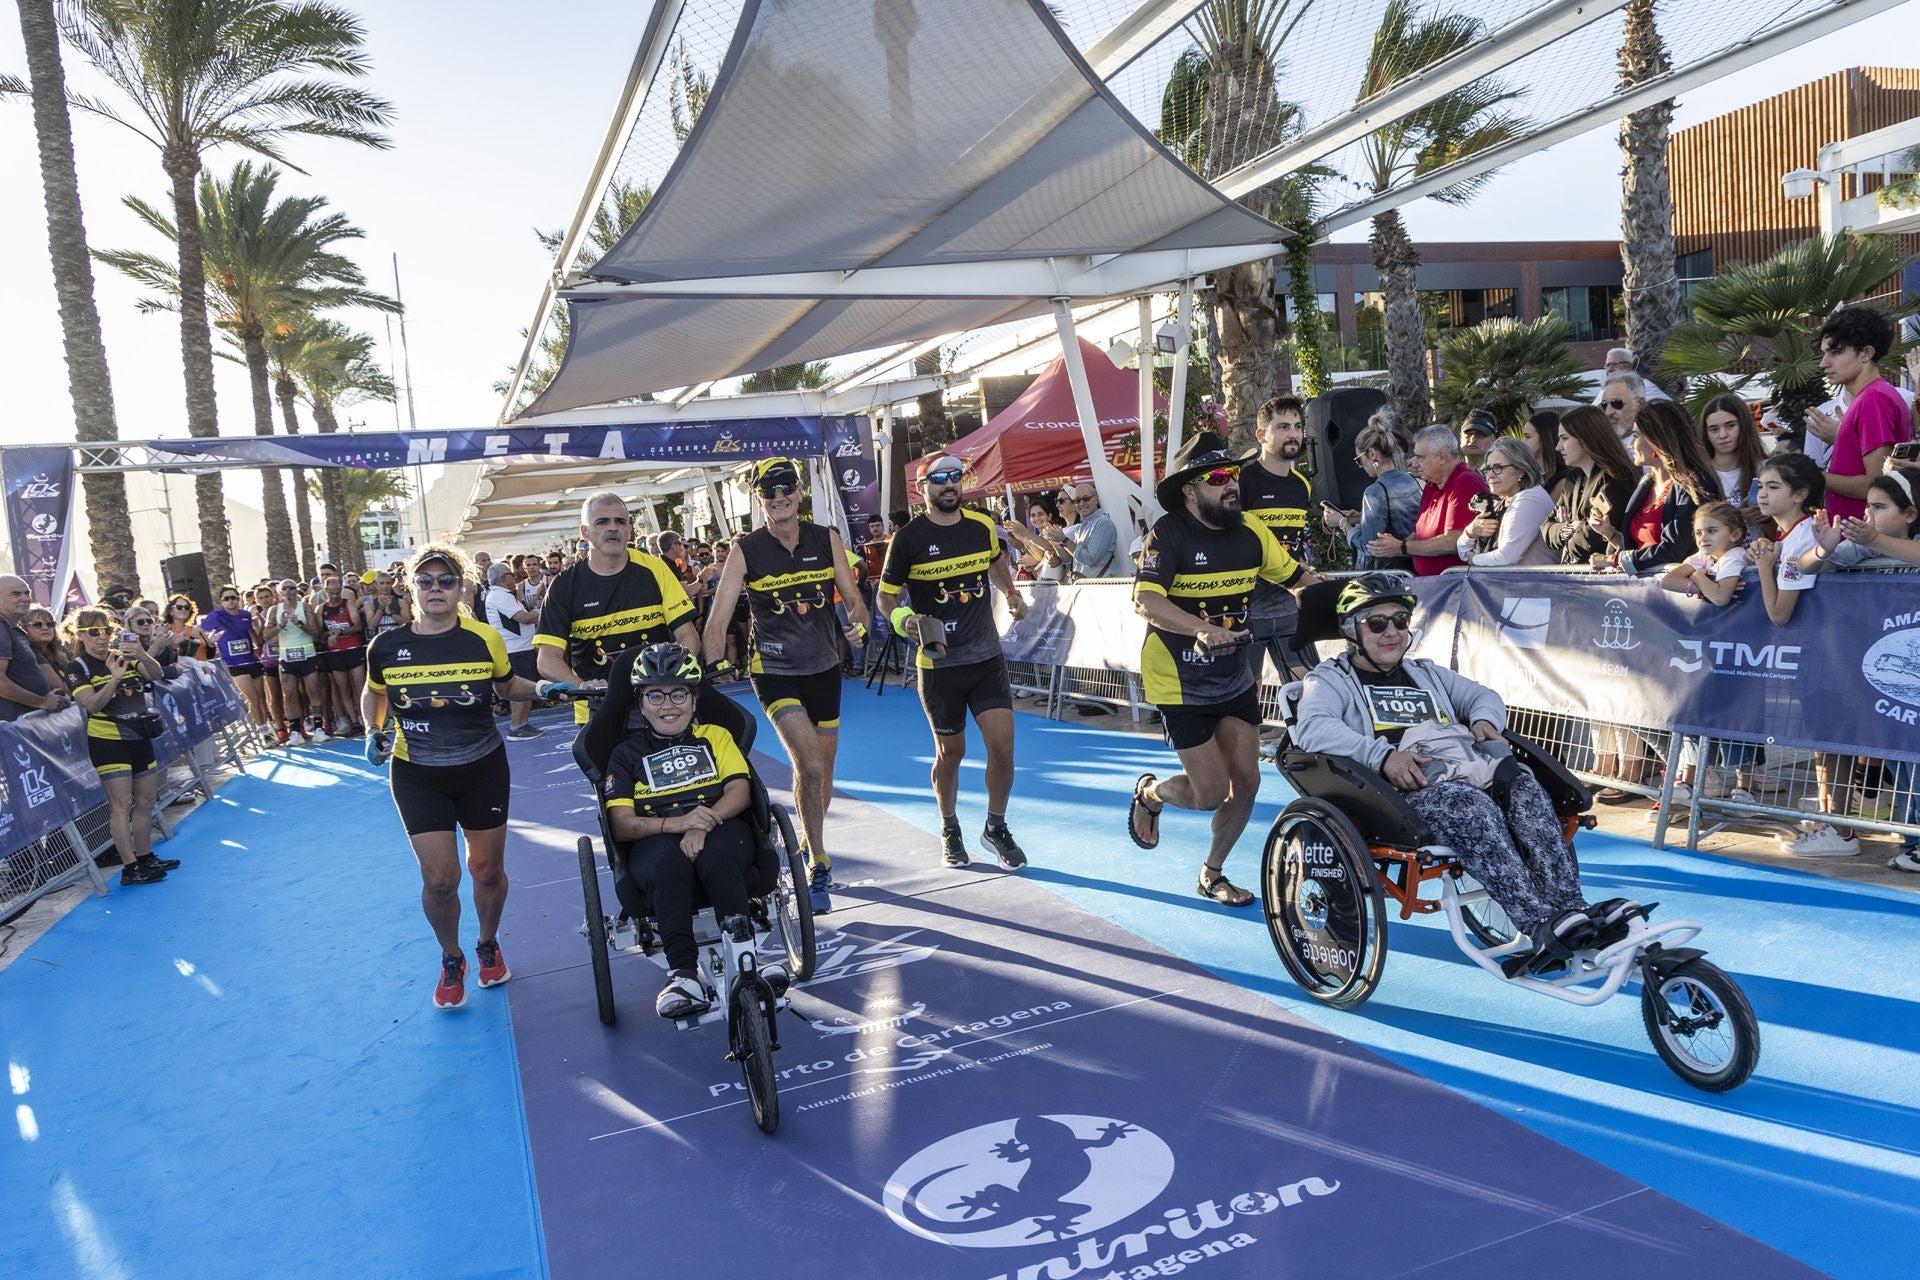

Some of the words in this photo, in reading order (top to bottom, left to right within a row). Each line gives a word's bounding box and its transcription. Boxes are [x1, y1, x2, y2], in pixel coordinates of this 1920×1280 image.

[1025, 416, 1141, 430] Cronoetra
[407, 431, 626, 464] META
[650, 444, 707, 454] CARRERA
[743, 439, 809, 449] SOLIDARIA
[1172, 579, 1219, 591] ZANCADAS
[1219, 577, 1245, 588] SOBRE
[611, 615, 641, 627] SOBRE
[1882, 610, 1920, 631] AMA
[1709, 641, 1801, 670] TMC
[1710, 668, 1736, 676] Terminal
[1769, 672, 1797, 680] Cartagena
[1394, 689, 1405, 697] IX
[1377, 700, 1428, 714] 1001
[1874, 698, 1920, 726] CAR
[402, 720, 430, 732] UPCT
[671, 748, 681, 756] IX
[661, 754, 698, 775] 869
[19, 765, 51, 796] 10K
[1311, 867, 1344, 879] FINISHER
[1302, 942, 1356, 973] Joëlette
[708, 1060, 835, 1097] Purto
[844, 1046, 888, 1063] de
[896, 1000, 1072, 1049] Cartagena
[796, 1083, 876, 1112] Autoridad
[876, 1067, 953, 1092] Portuaria
[955, 1060, 974, 1072] de
[974, 1041, 1053, 1066] Cartagena
[985, 1176, 1342, 1280] ntriton
[1097, 1232, 1257, 1280] tagena
